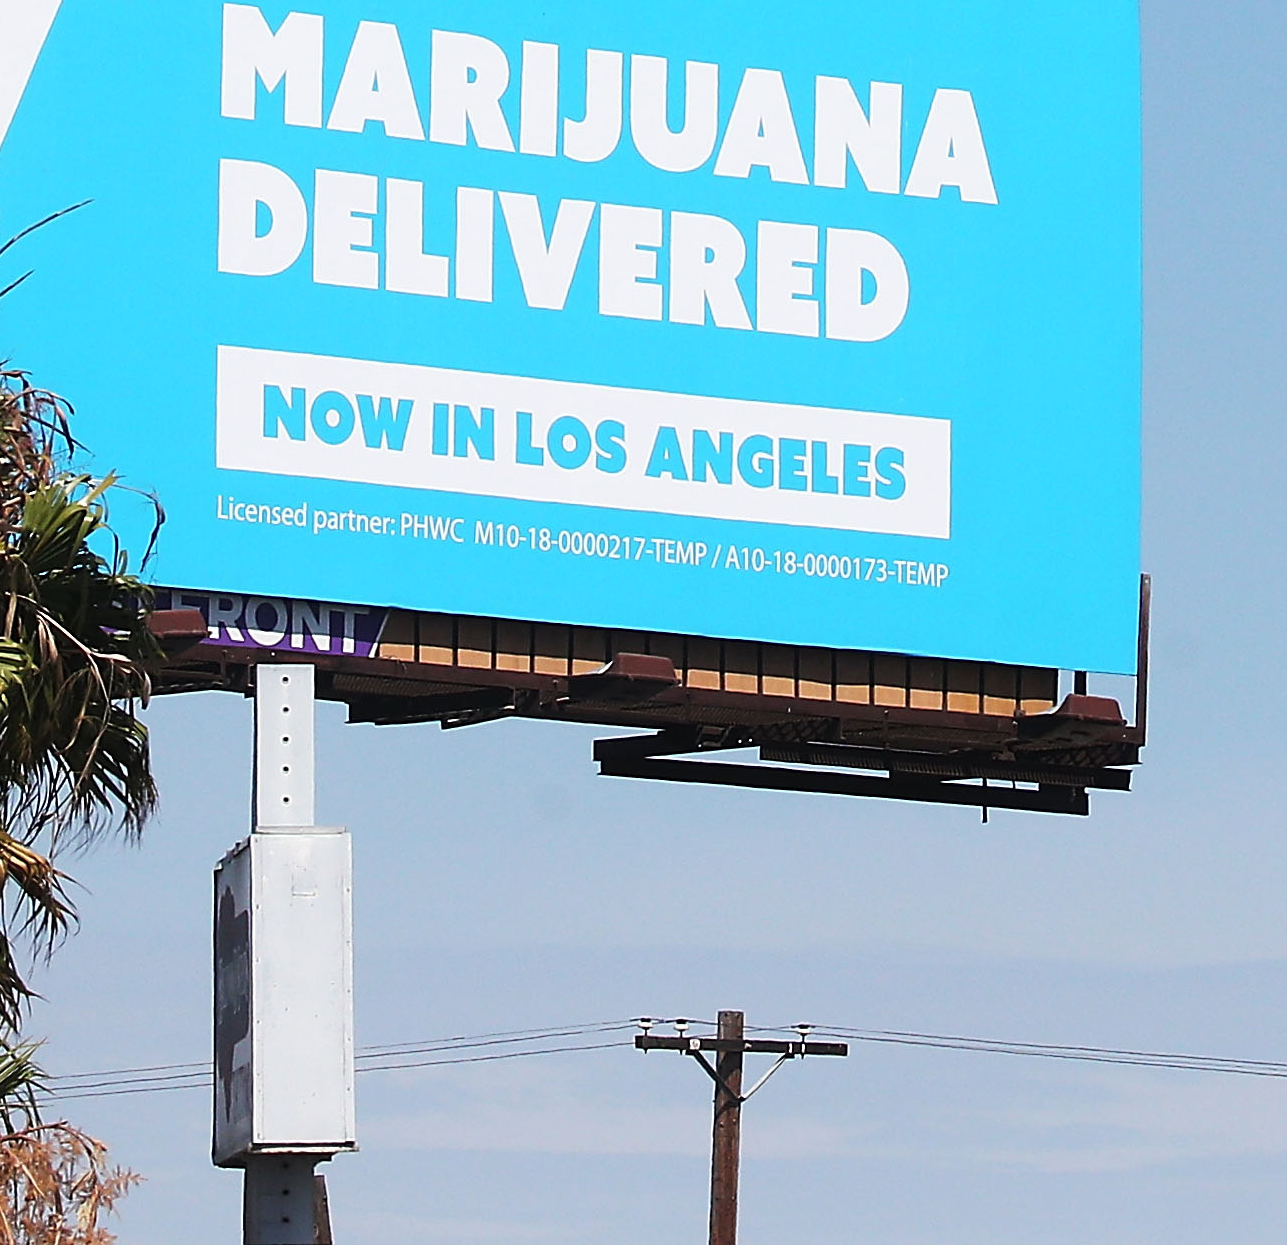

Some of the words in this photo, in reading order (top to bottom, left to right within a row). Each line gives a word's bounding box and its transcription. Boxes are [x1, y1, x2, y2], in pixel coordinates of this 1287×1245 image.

[220, 2, 999, 205] MARIJUANA
[217, 158, 910, 343] DELIVERED
[262, 384, 414, 452] NOW
[431, 403, 495, 461] IN
[515, 411, 627, 474] LOS
[645, 426, 907, 501] ANGELES
[217, 494, 308, 527] Licensed
[313, 509, 397, 536] partner:
[400, 512, 465, 543] PHWC
[474, 520, 708, 566] M10-18-0000217-TEMP
[711, 544, 722, 568] /
[725, 545, 949, 588] A10-18-0000173-TEMP
[155, 590, 370, 654] FRONT
